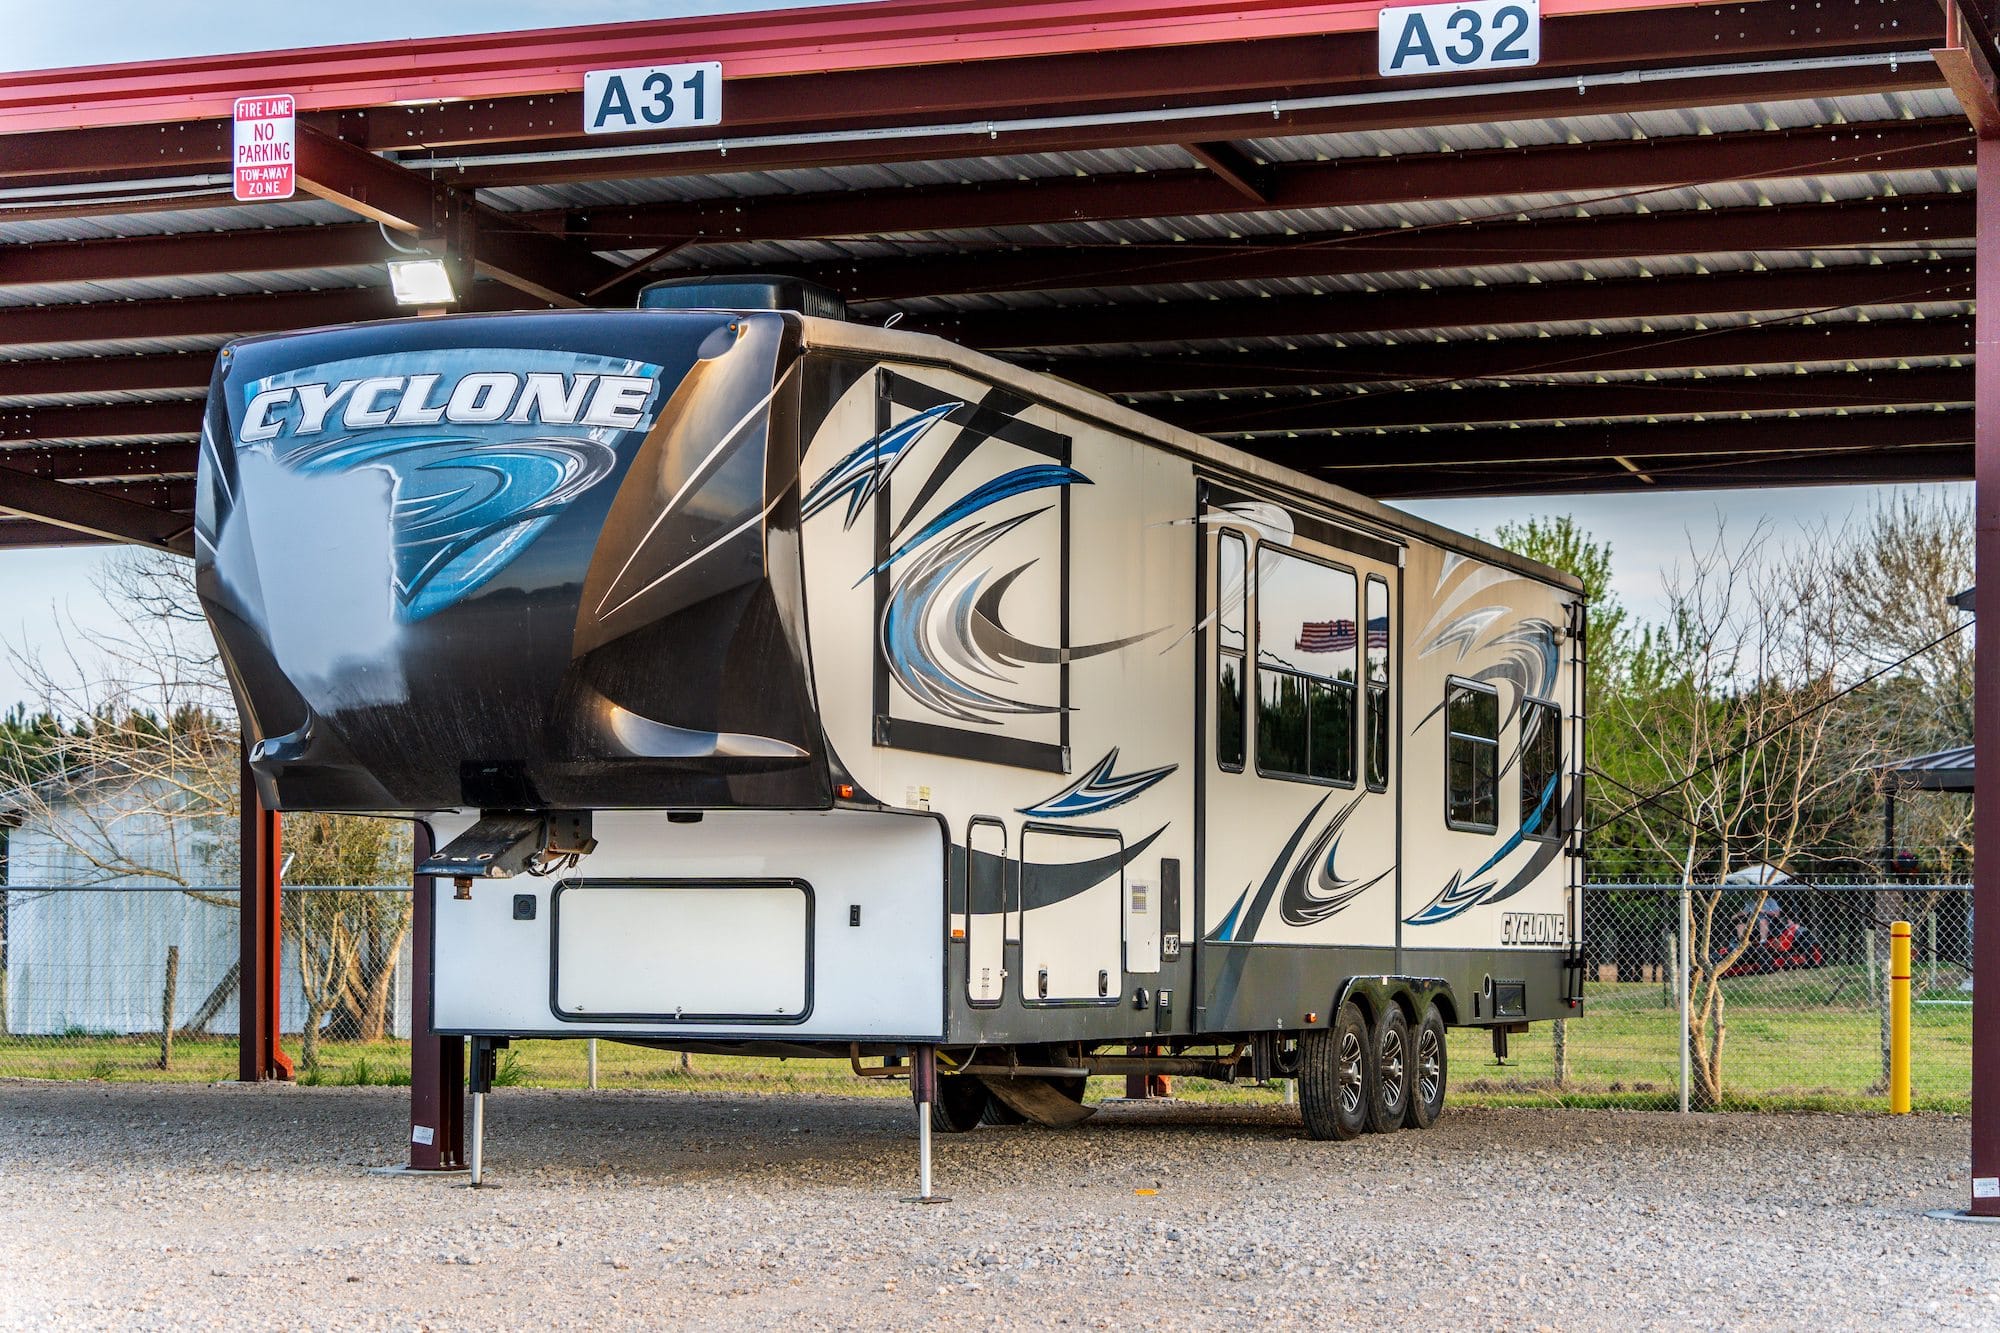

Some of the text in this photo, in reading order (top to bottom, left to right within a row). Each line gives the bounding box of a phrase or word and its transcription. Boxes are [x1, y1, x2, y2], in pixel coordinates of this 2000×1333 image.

[1390, 5, 1529, 69] A32
[239, 100, 291, 118] FIRE LANE
[593, 69, 705, 128] A31
[254, 122, 274, 141] NO
[239, 142, 290, 163] PARKING
[240, 167, 288, 182] TOW-AWAY
[248, 181, 280, 195] ZONE
[238, 372, 654, 443] CYCLONE
[1501, 912, 1565, 945] CYCLONE
